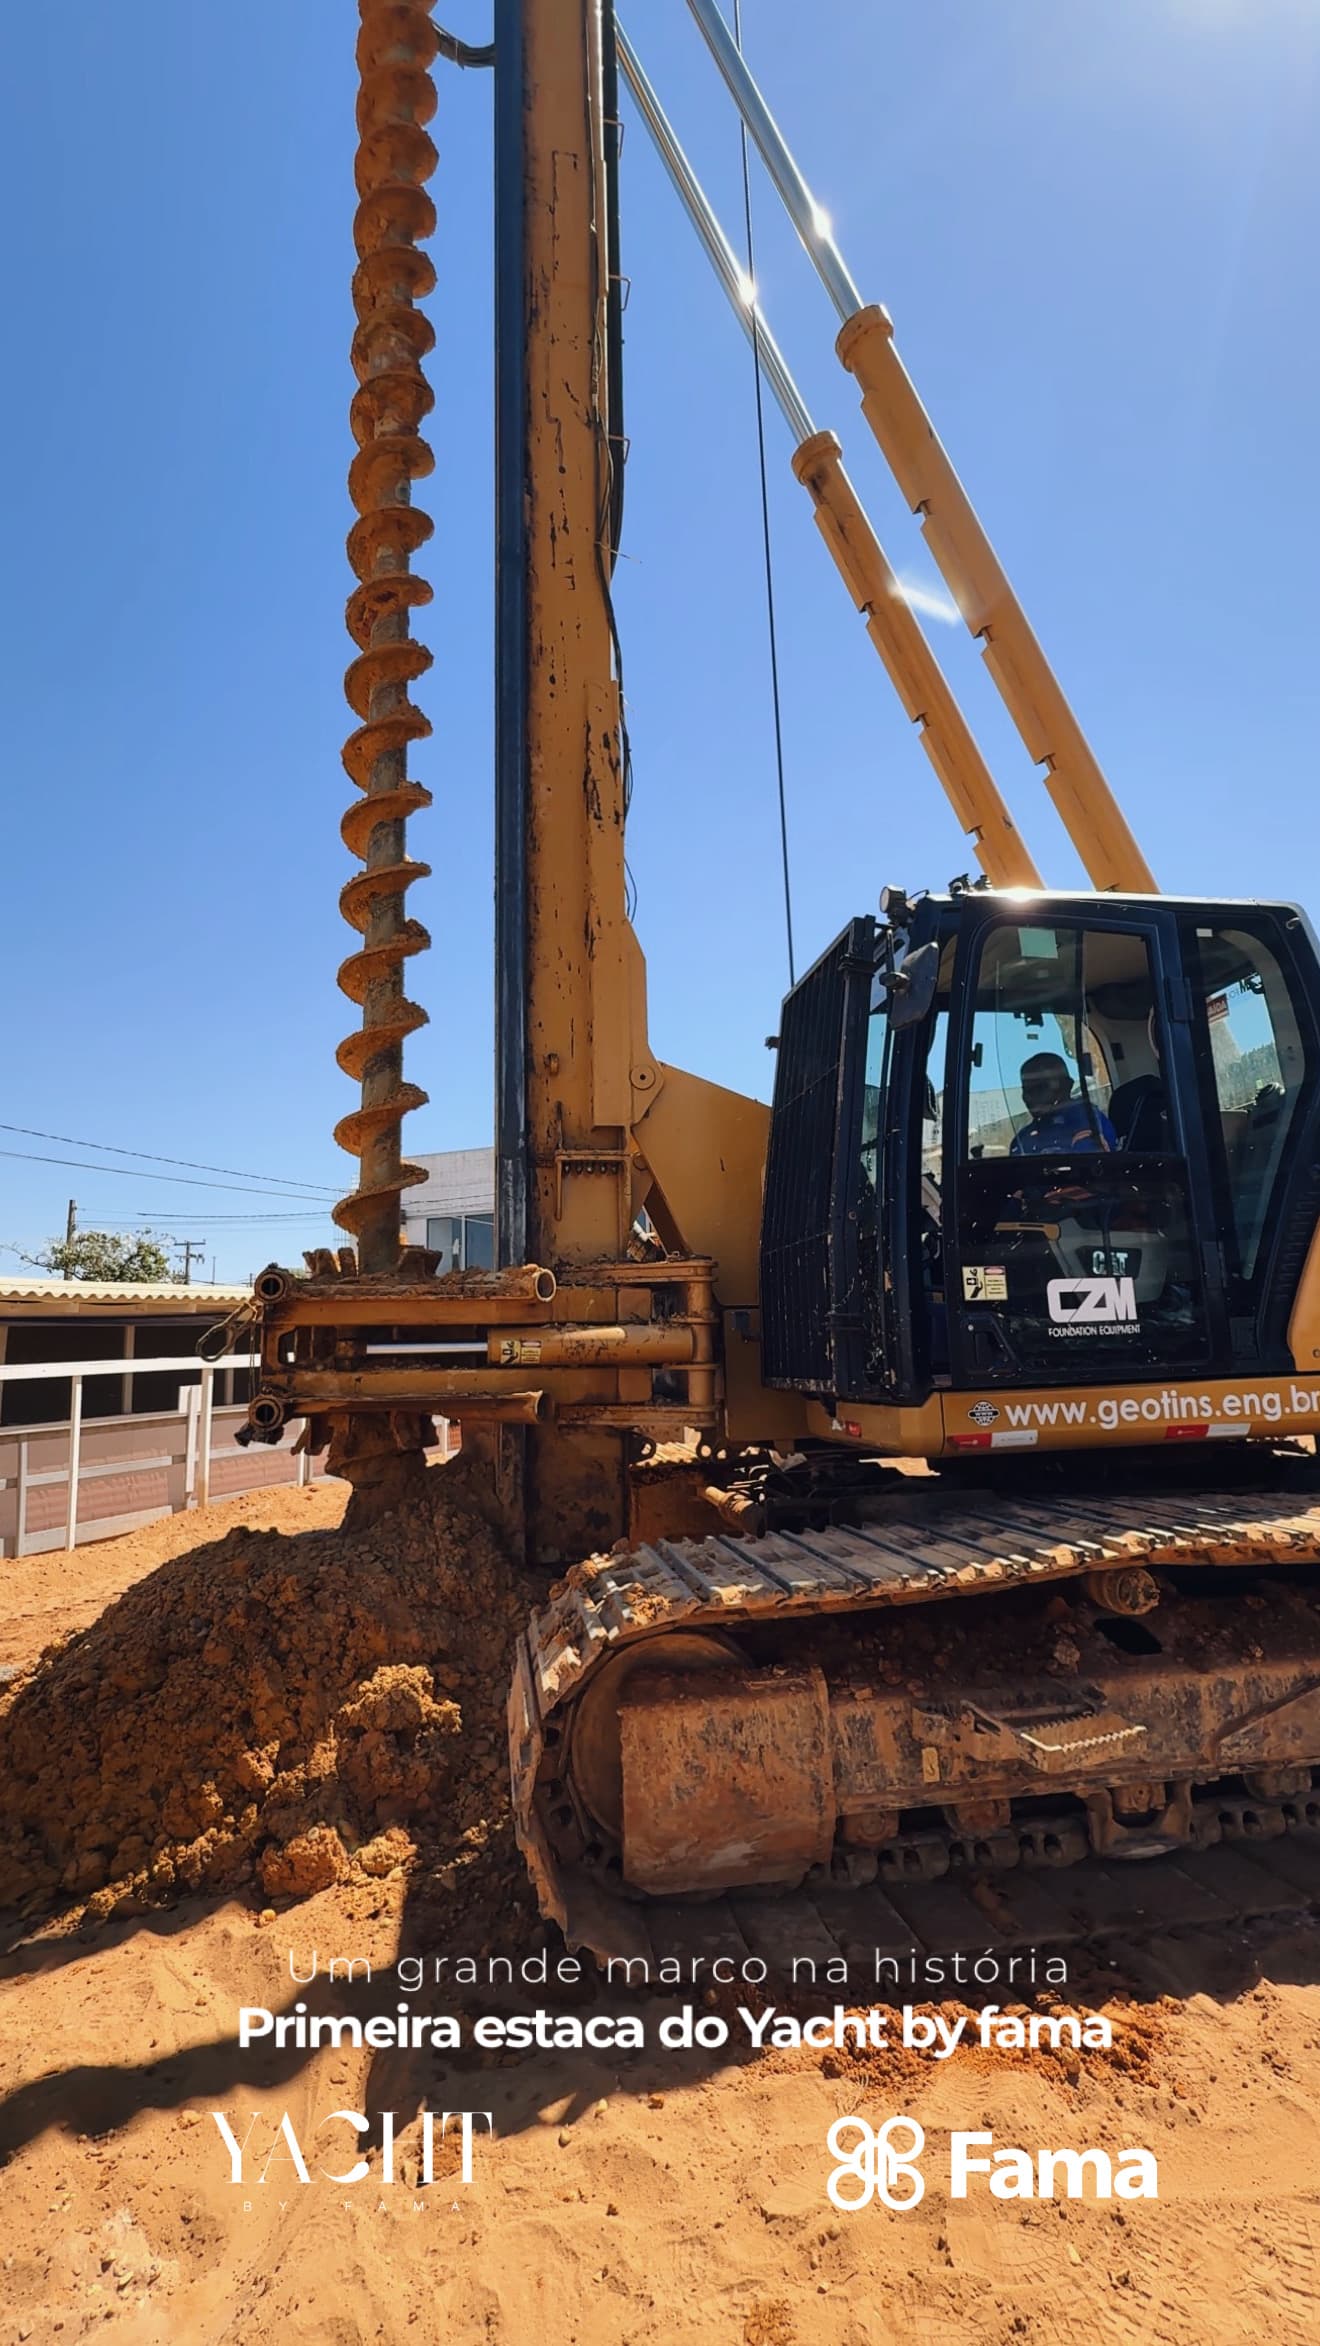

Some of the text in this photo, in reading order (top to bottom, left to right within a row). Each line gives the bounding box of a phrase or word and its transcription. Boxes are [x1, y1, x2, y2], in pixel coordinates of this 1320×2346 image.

[1047, 1277, 1138, 1323] CZM
[1048, 1324, 1140, 1337] FOUNDATION EQUIPMENT
[1004, 1384, 1320, 1430] www.geotins.eng.br
